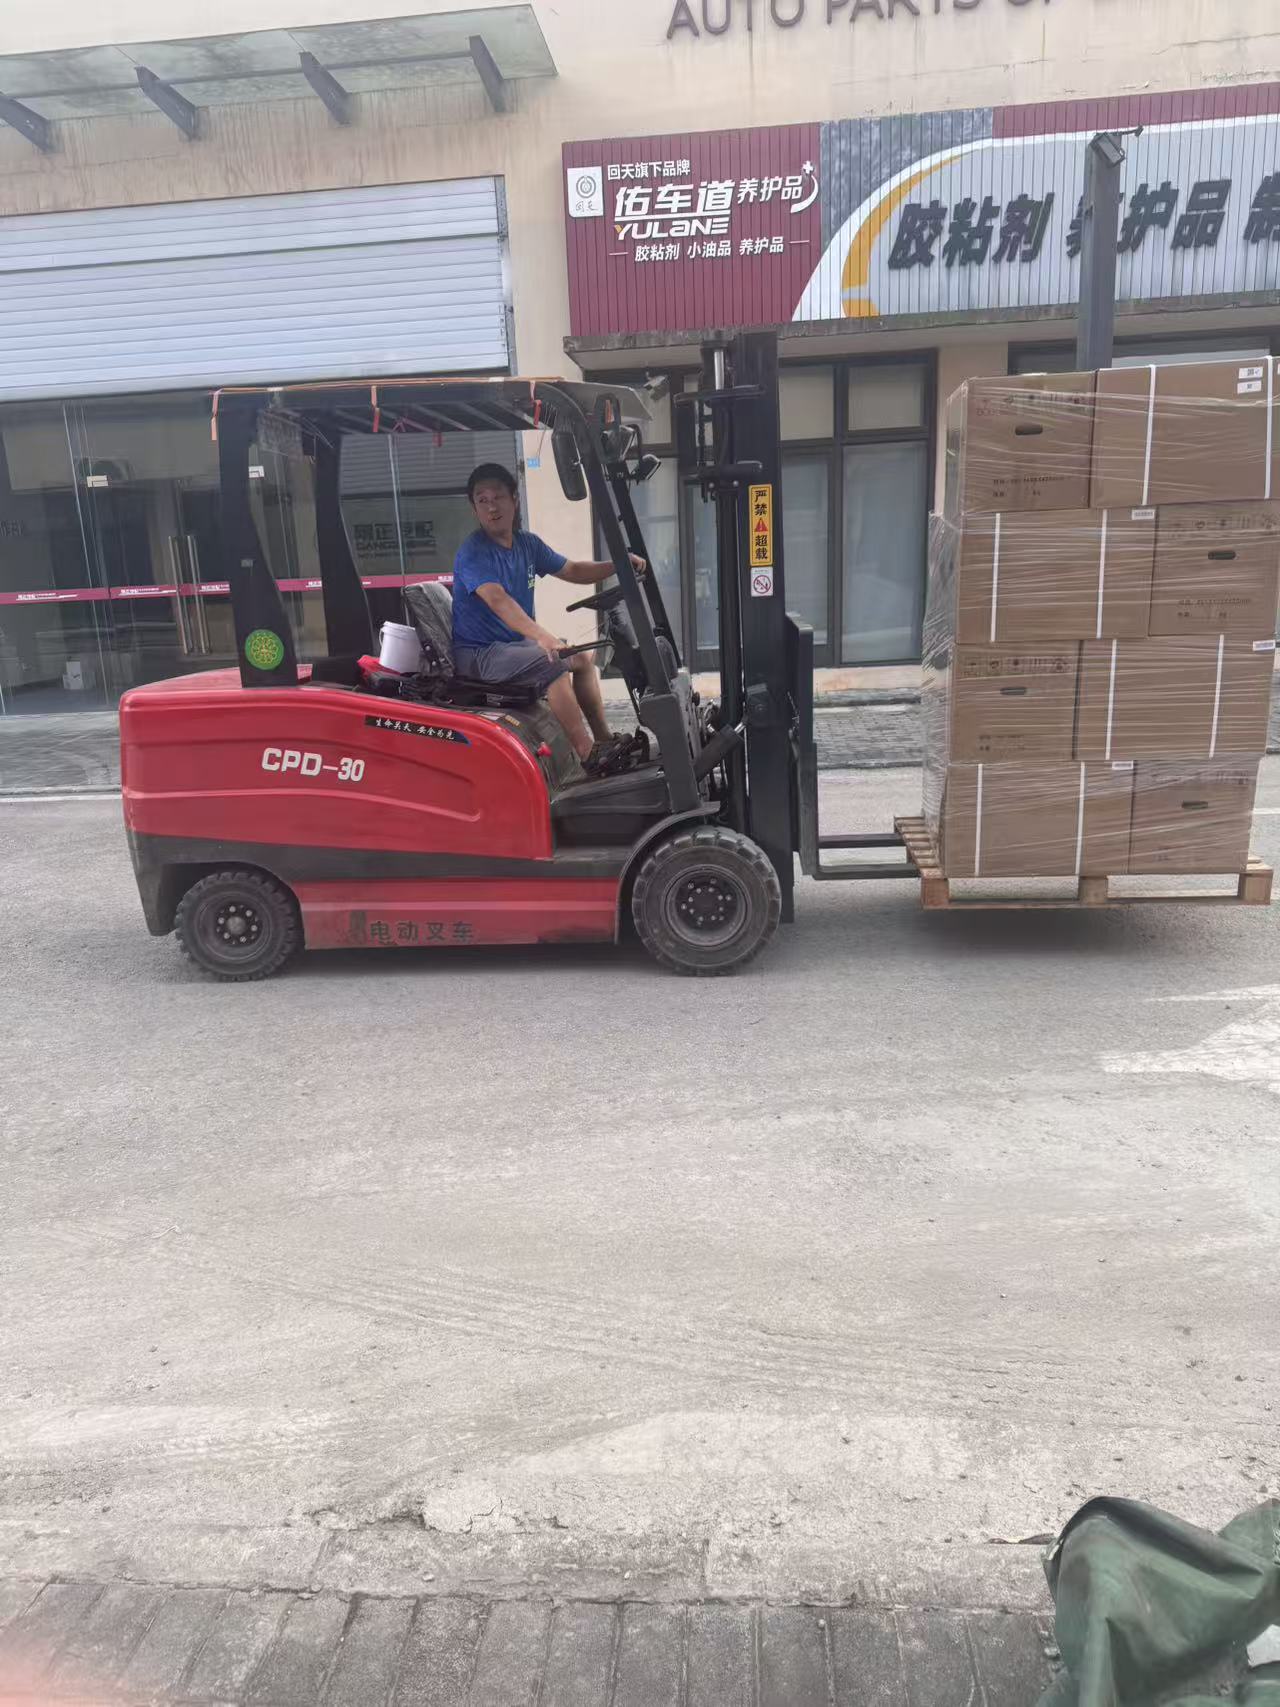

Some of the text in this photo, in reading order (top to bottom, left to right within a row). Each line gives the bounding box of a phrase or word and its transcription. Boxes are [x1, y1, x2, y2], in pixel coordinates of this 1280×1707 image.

[667, 0, 805, 39] AUTO
[607, 159, 691, 181] 回天旗下品牌
[614, 175, 803, 214] 佑车道 养护品
[887, 191, 1055, 269] 胶粘剂
[635, 236, 784, 262] 胶粘剂 小油品 养护品
[754, 490, 768, 516] 严禁
[262, 747, 365, 782] CPD-30
[369, 920, 474, 945] 电动叉车
